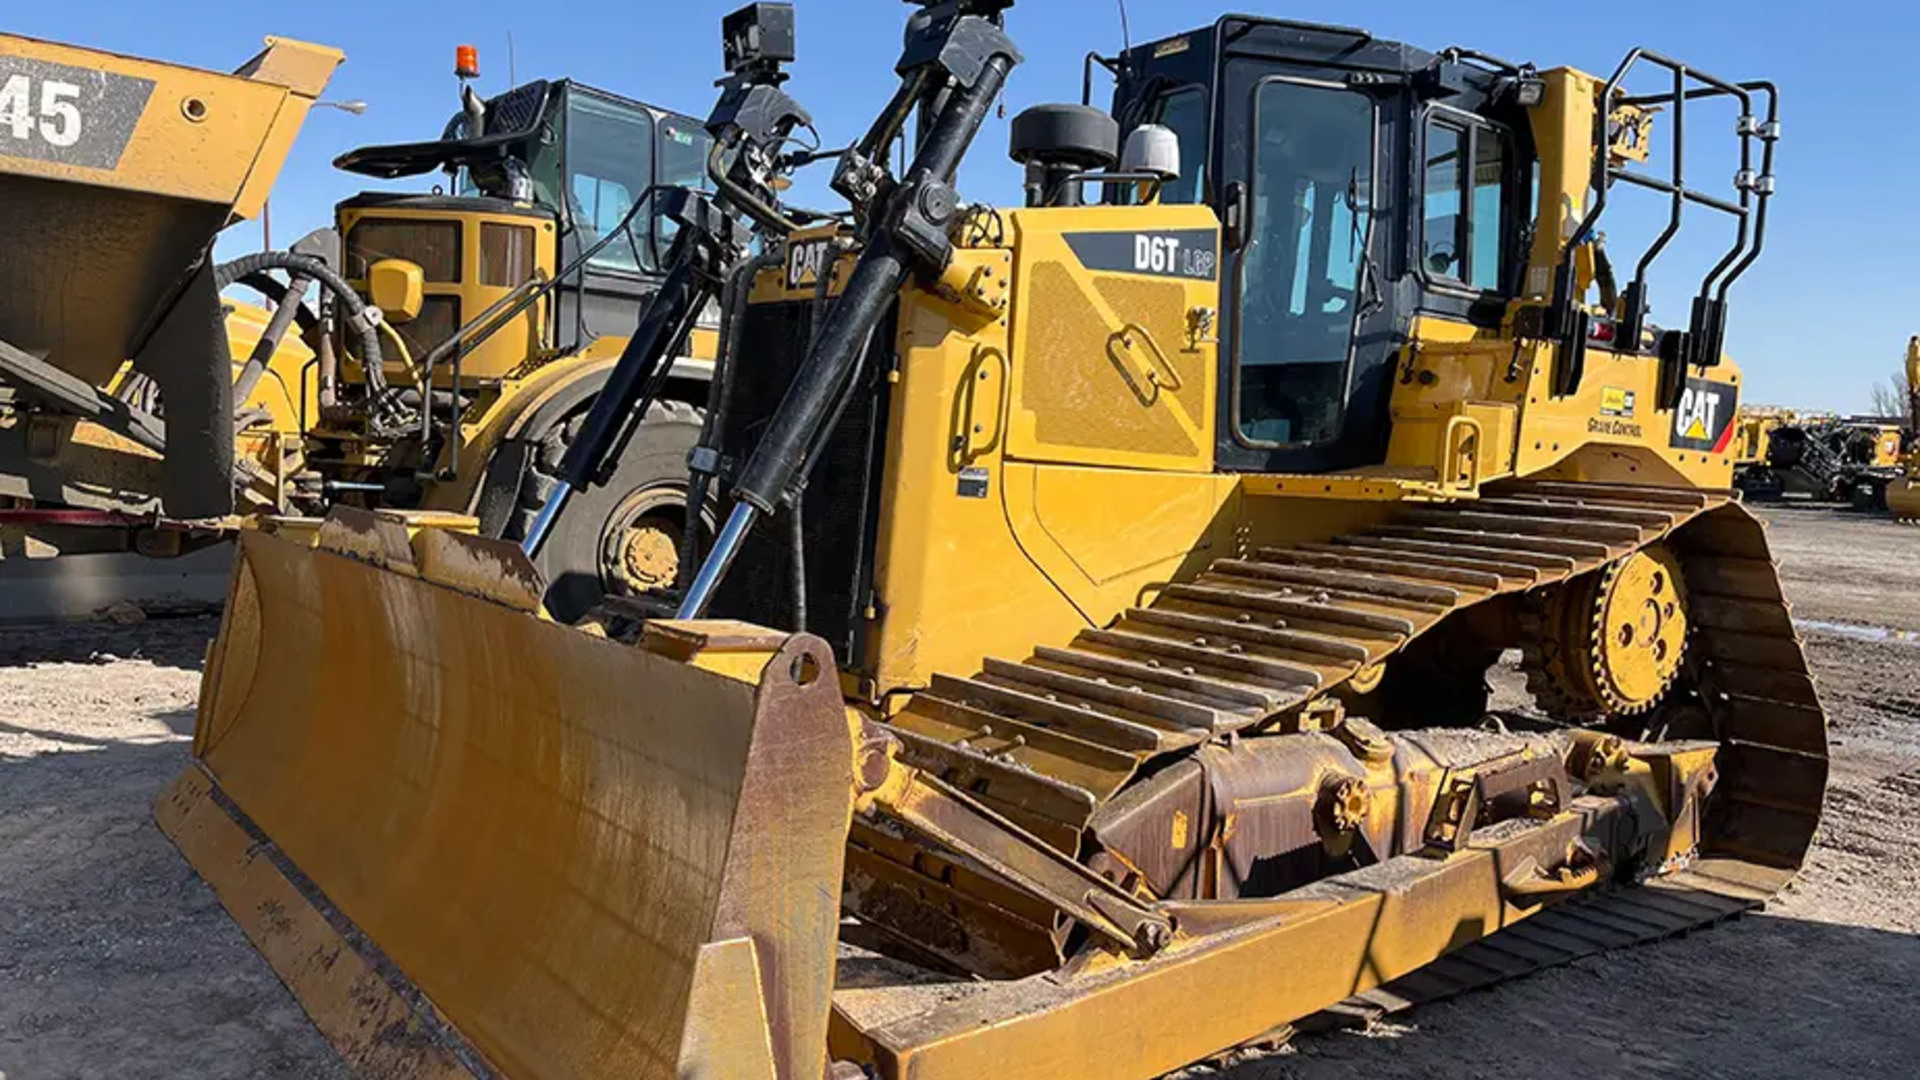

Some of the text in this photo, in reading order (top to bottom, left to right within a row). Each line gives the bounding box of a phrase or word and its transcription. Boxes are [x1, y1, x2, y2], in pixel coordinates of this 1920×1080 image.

[0, 74, 82, 146] 45
[790, 243, 828, 285] CAT
[1135, 234, 1179, 272] D6T
[1676, 387, 1720, 440] CAT
